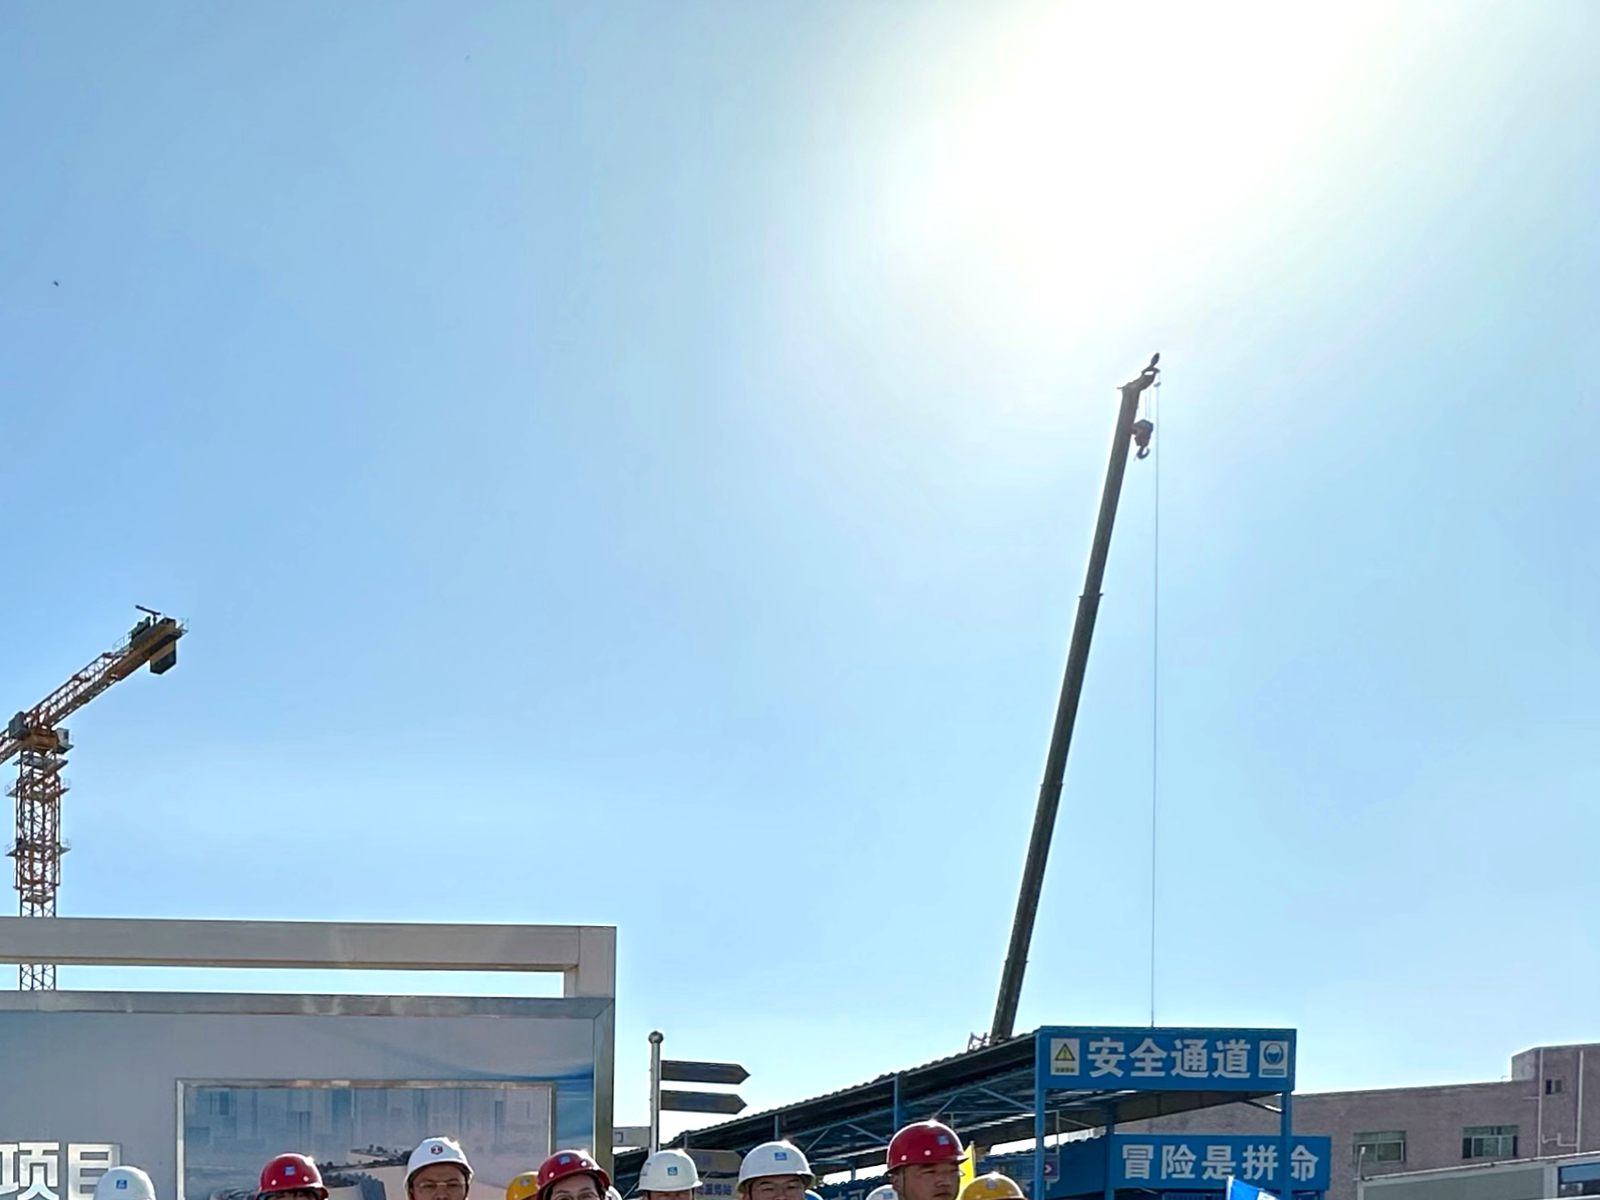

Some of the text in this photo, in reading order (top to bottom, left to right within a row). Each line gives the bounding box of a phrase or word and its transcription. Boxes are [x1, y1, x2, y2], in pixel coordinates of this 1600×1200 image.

[1088, 1037, 1251, 1078] 安全通道
[1121, 1144, 1319, 1181] 冒险是拼命
